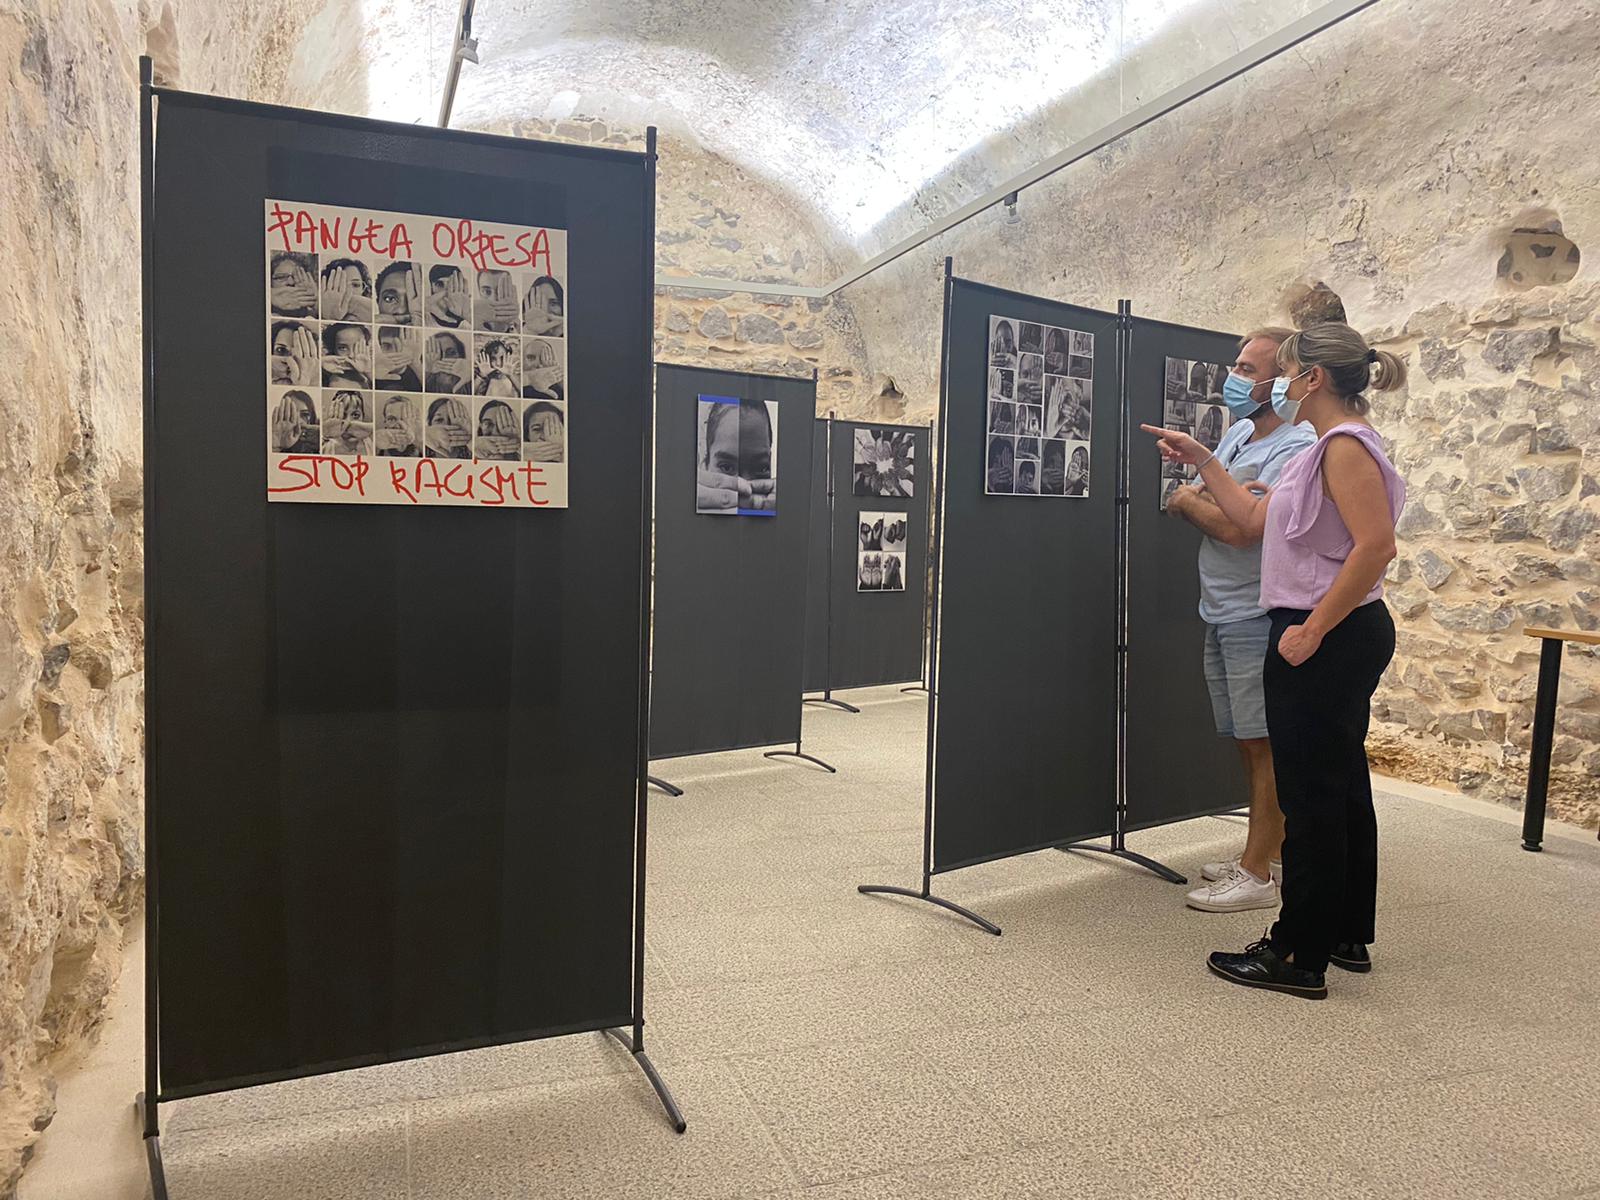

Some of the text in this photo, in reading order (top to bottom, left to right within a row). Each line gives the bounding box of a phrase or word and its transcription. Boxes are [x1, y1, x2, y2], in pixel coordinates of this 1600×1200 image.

[267, 202, 553, 277] PANGEA ORPESA
[267, 454, 369, 496] STOP
